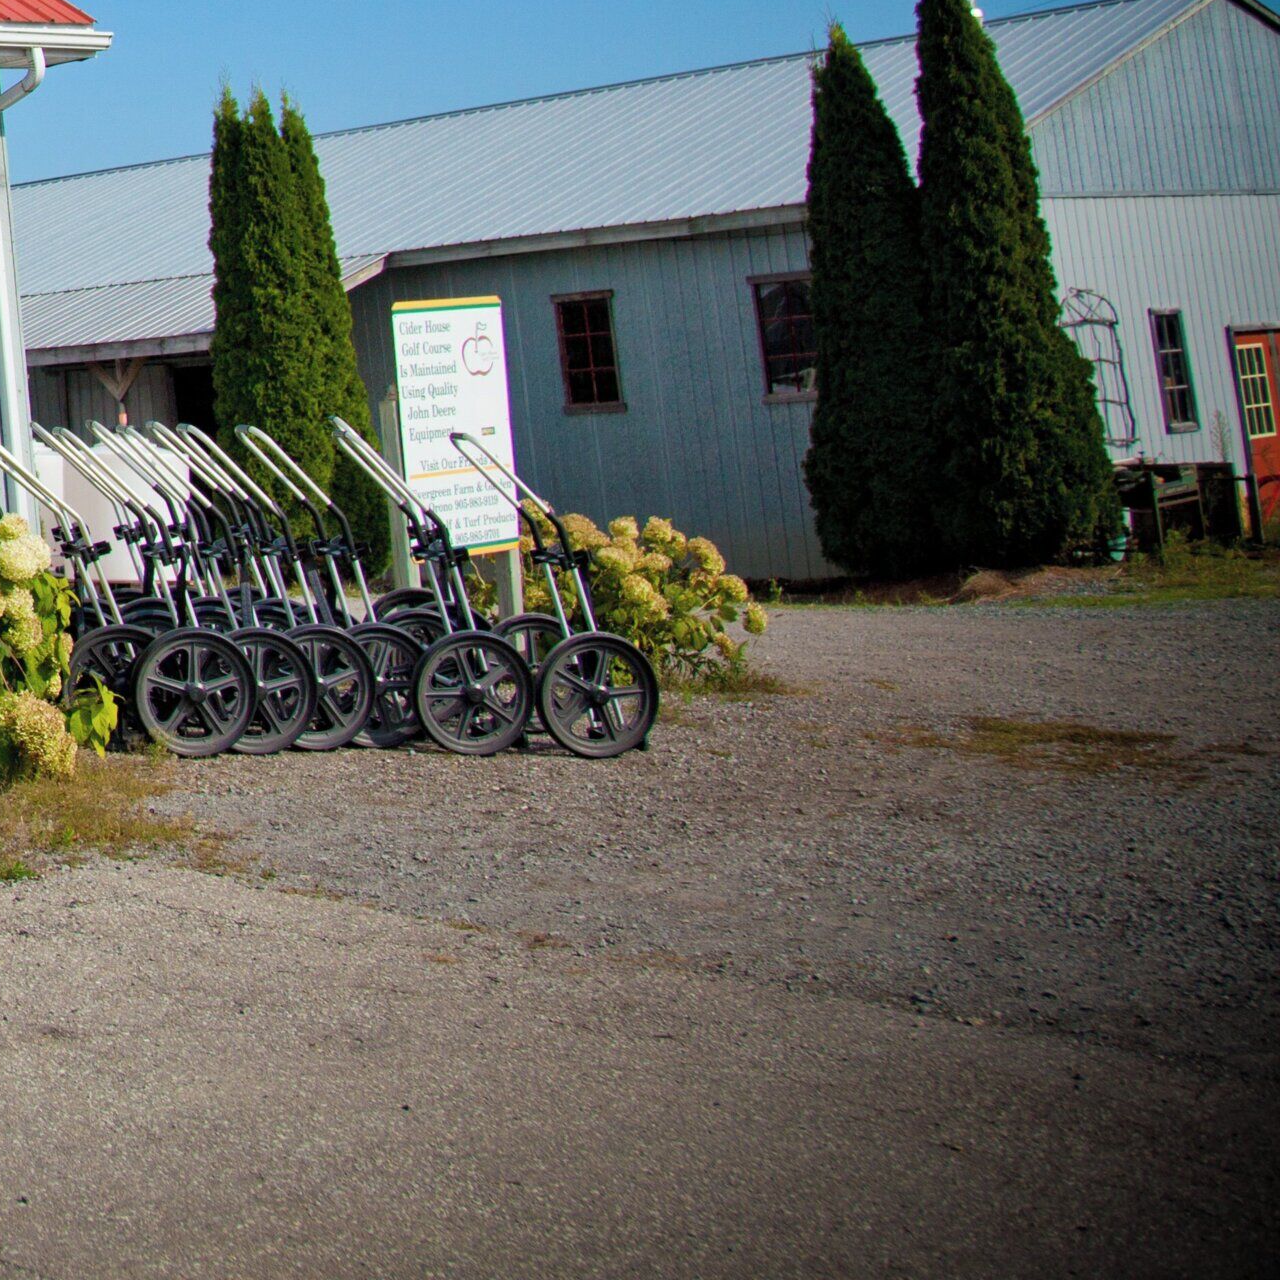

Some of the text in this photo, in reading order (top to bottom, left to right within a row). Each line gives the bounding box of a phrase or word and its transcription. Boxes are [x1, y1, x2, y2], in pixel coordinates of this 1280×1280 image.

[399, 320, 450, 335] Cider House
[401, 341, 452, 357] Golf Course
[409, 360, 457, 377] Maintained
[402, 382, 458, 400] Using Quality
[407, 404, 456, 420] John Deere
[420, 458, 439, 471] Visit
[441, 458, 458, 469] Our
